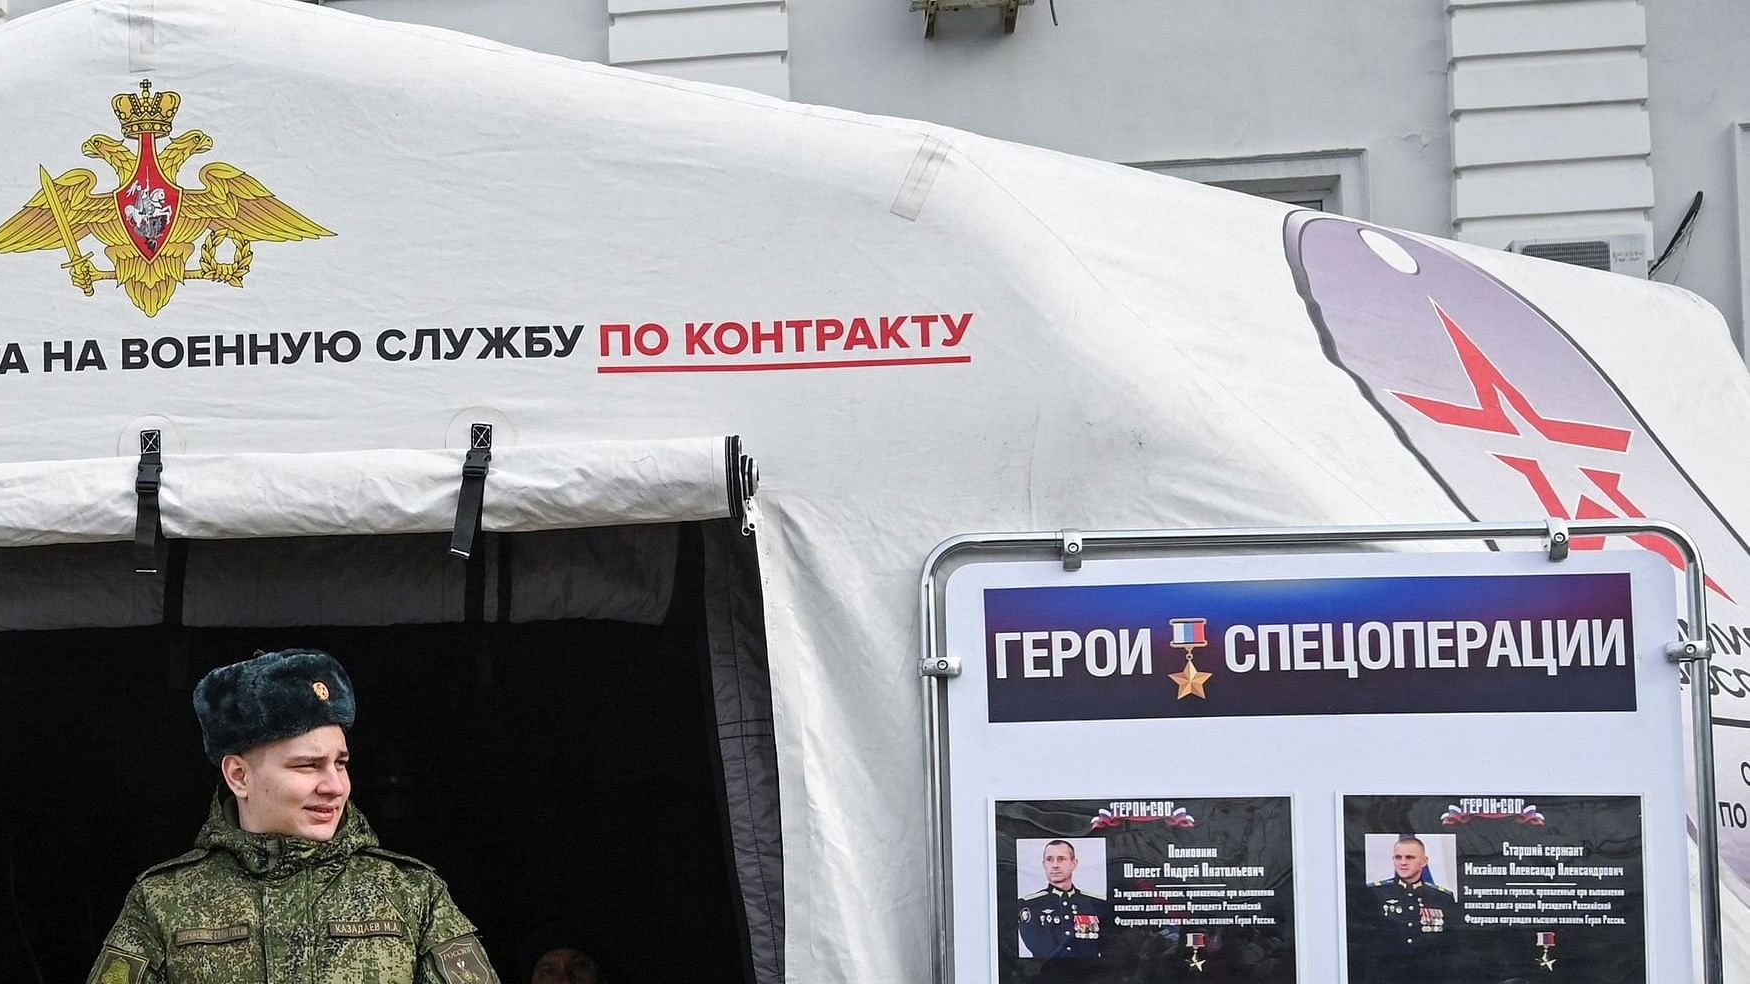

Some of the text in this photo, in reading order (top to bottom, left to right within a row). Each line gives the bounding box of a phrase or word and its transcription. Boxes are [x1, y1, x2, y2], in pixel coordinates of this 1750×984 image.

[41, 337, 108, 375] НА
[121, 327, 362, 371] ВОЕННУЮ
[374, 322, 585, 363] СЛУЖБУ
[597, 322, 670, 358] ПО
[683, 312, 975, 357] КОНТРАКТУ
[994, 627, 1153, 679] ГЕРОИ
[1224, 618, 1627, 679] СПЕЦОПЕРАЦИИ
[1503, 841, 1584, 860] Старший сержант
[1123, 863, 1161, 878] Шелест
[1164, 863, 1199, 881] Андрей
[1464, 862, 1623, 880] Михайлов Александр Александрович
